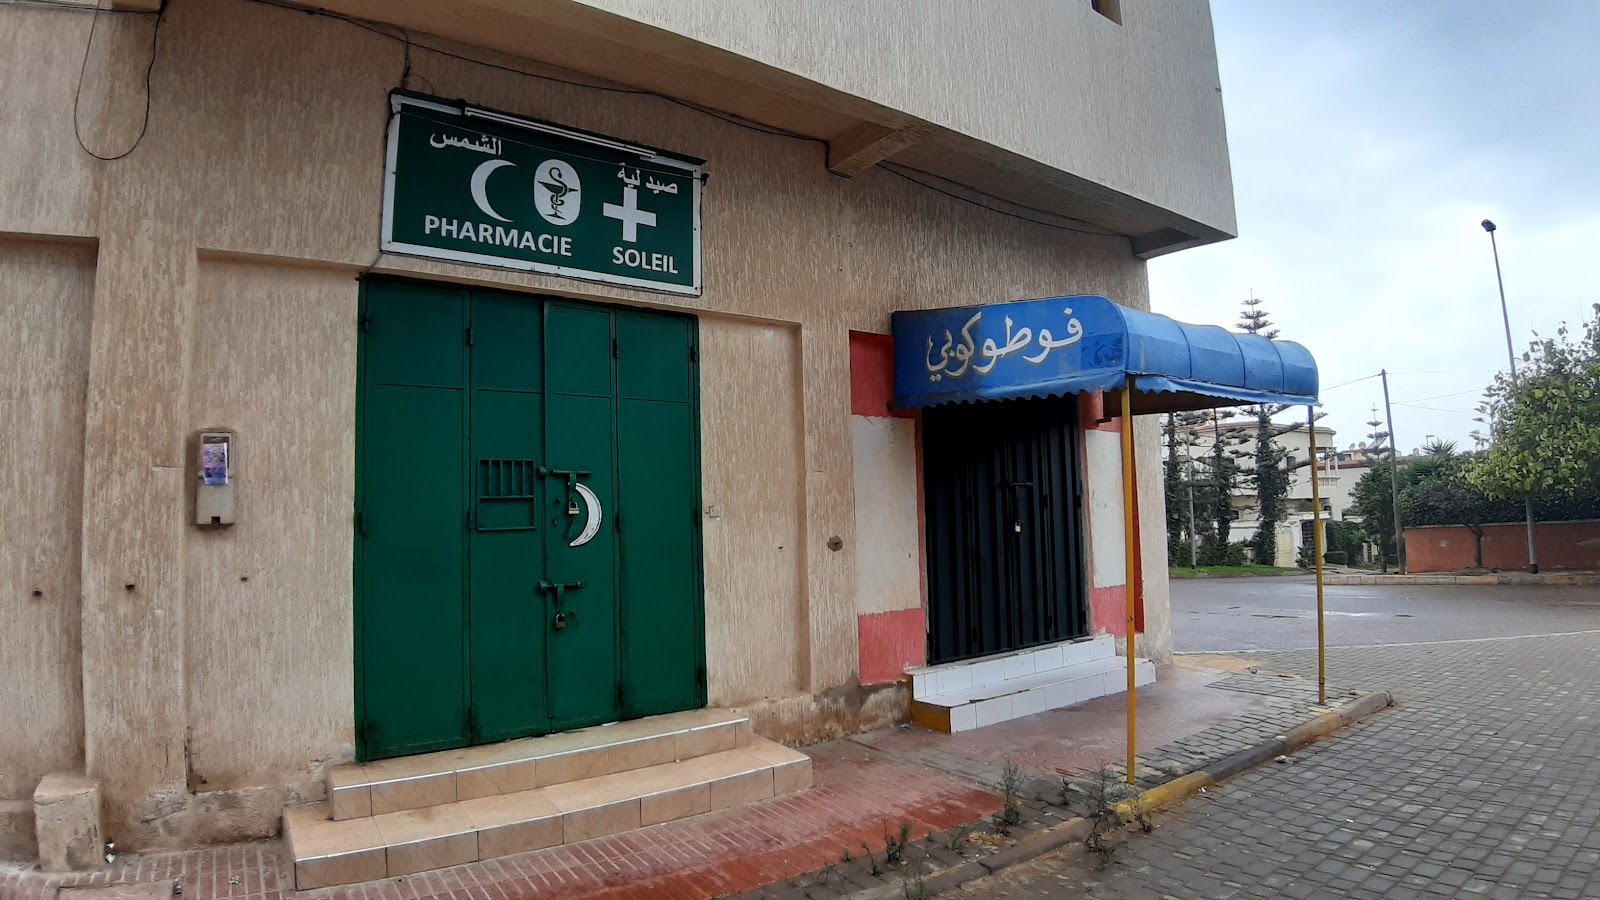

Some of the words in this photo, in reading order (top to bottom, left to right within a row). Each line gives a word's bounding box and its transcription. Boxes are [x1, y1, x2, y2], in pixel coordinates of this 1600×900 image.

[429, 133, 502, 156] الشمس
[424, 214, 573, 257] PHARMACIE
[612, 246, 679, 274] SOLEIL
